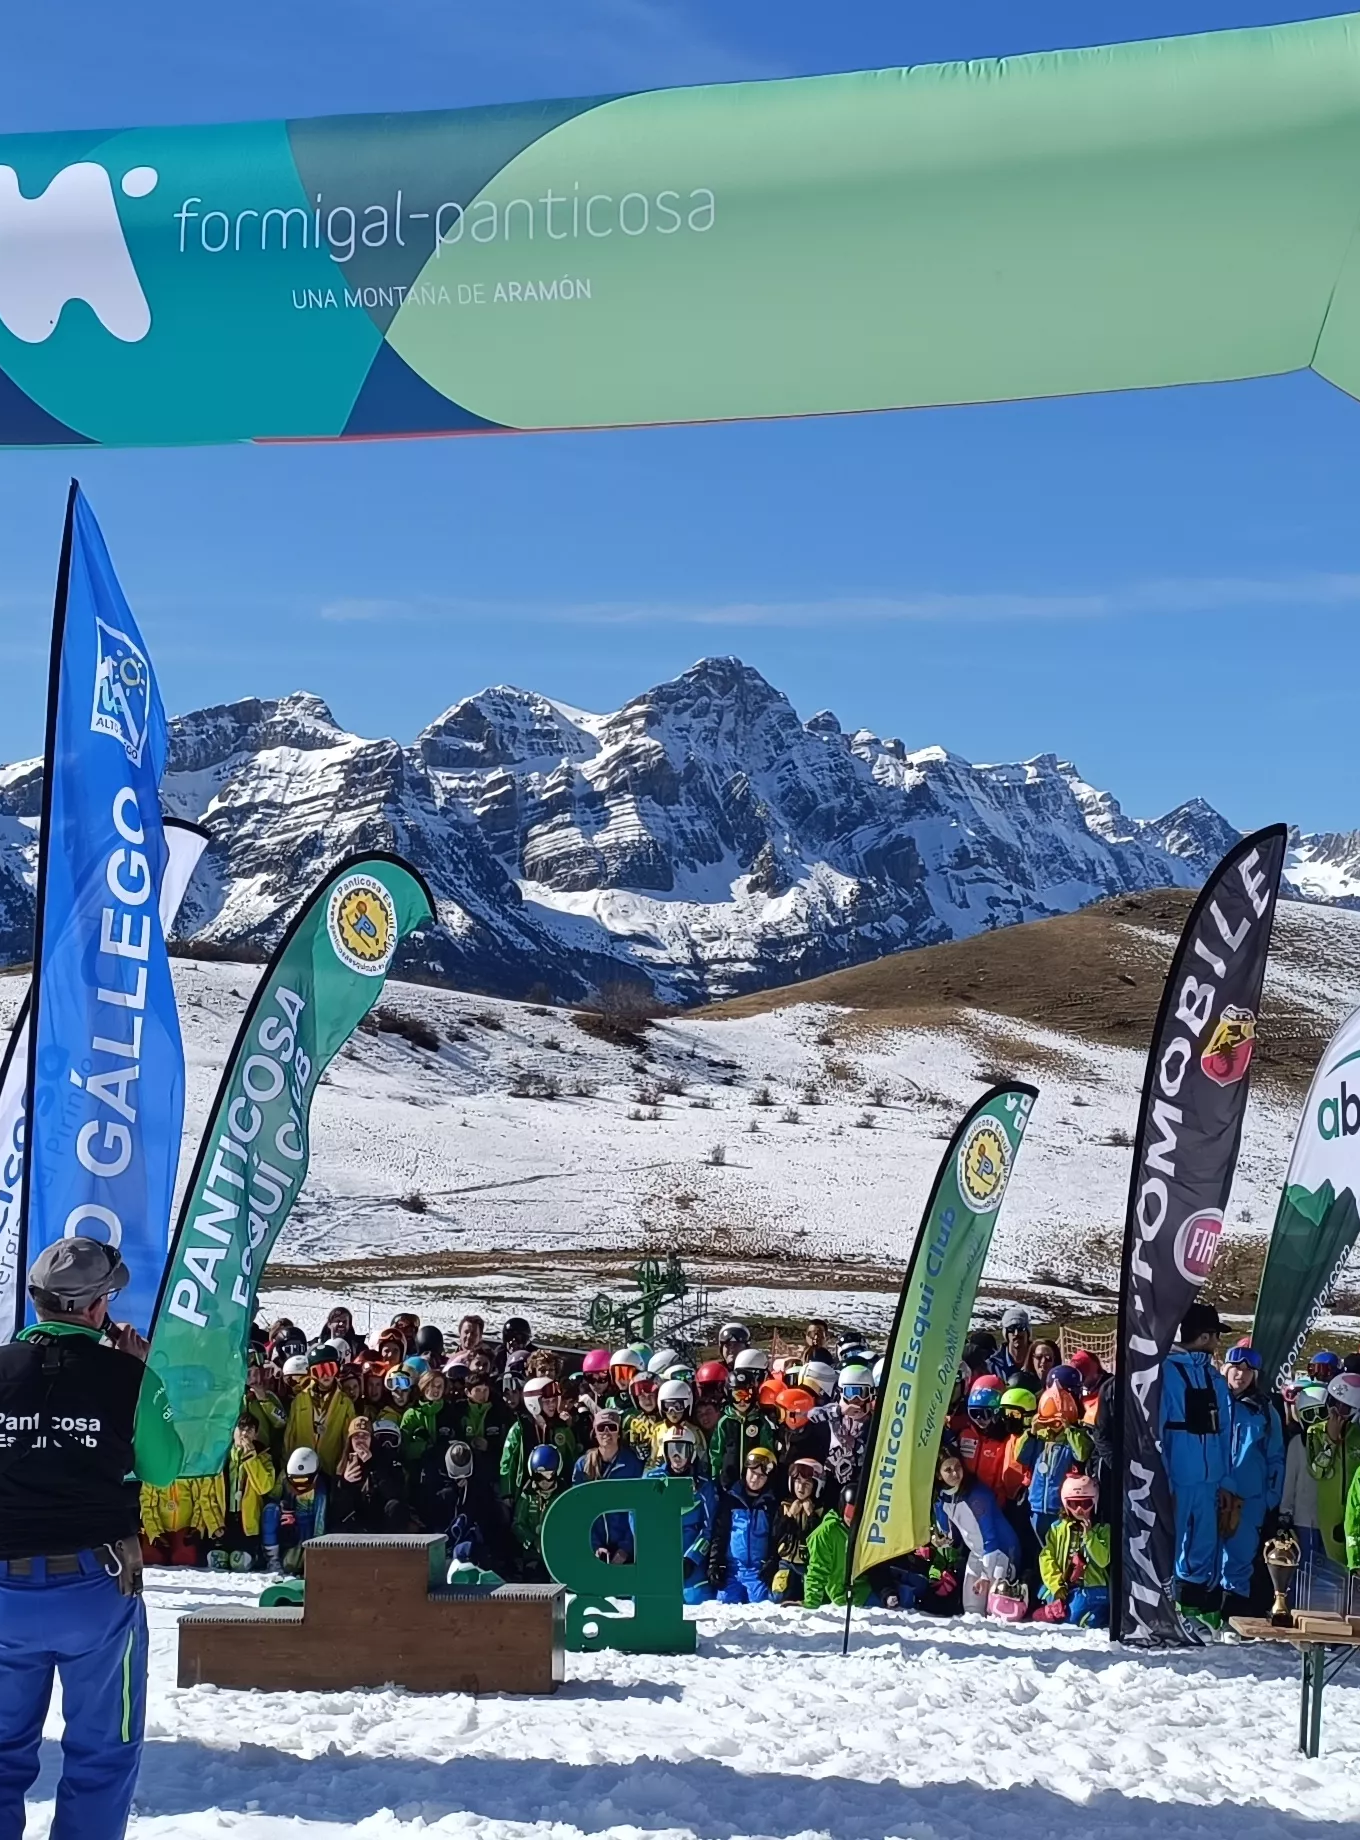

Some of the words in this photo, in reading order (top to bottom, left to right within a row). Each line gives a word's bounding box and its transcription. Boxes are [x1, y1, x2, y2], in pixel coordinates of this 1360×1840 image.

[173, 184, 716, 262] formigal-panticosa
[291, 287, 338, 309] UNA
[343, 281, 451, 308] MONTAÑA
[458, 283, 486, 304] DE
[493, 274, 592, 303] ARAMÓN
[337, 876, 382, 896] Panticosa
[168, 986, 306, 1327] PANTICOSA
[868, 1379, 912, 1545] Panticosa
[900, 1281, 936, 1374] Esqui
[926, 1206, 957, 1278] Club
